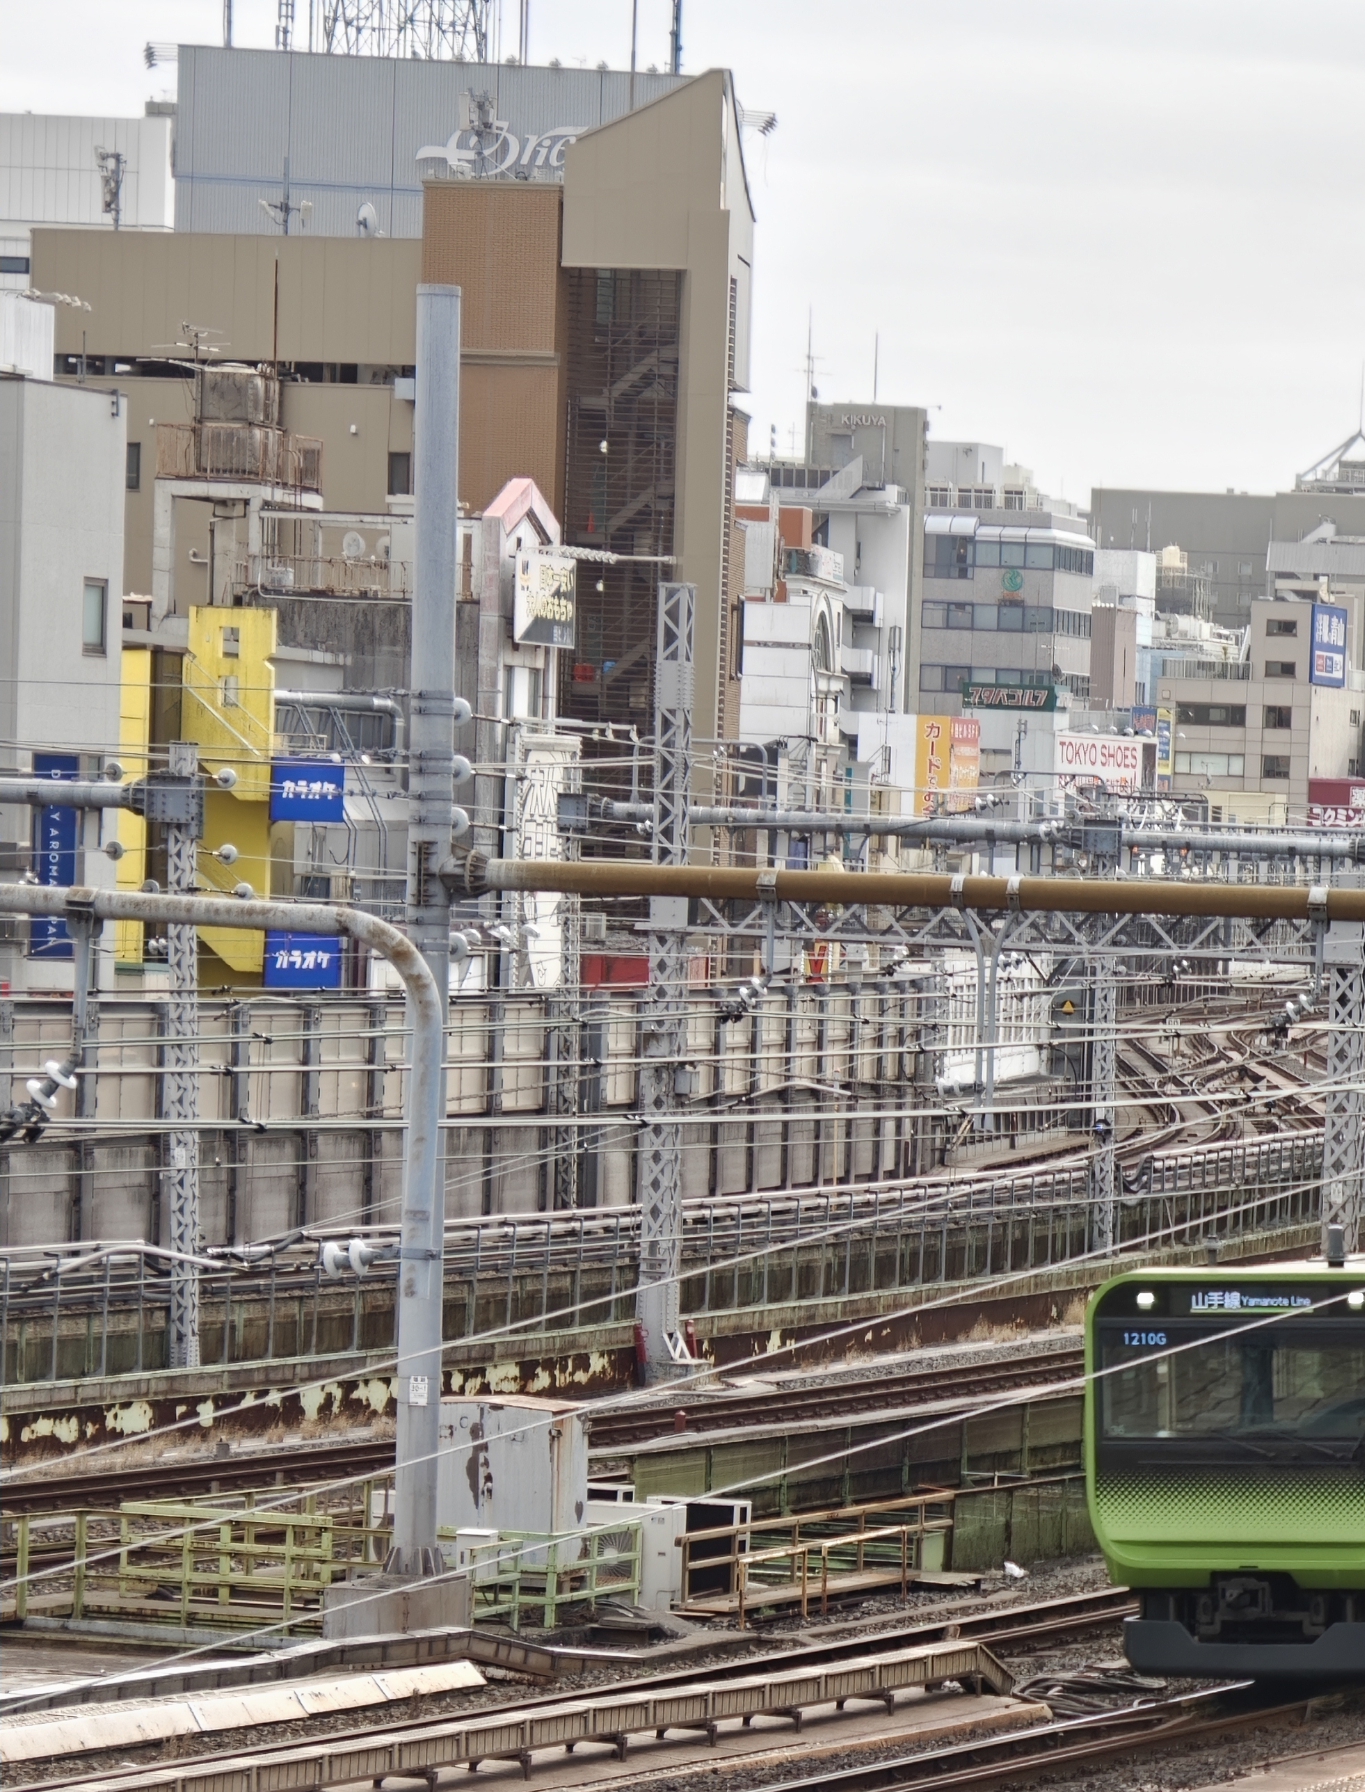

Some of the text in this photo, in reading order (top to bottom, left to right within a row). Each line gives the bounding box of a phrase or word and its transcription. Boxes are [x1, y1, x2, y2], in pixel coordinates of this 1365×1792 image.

[1059, 741, 1138, 769] TOKYO SHOES
[283, 781, 336, 799] カラオケ
[276, 950, 330, 969] カラオケ
[1191, 1291, 1311, 1310] 山手線 Yamanote Line
[1123, 1332, 1166, 1346] 1210G
